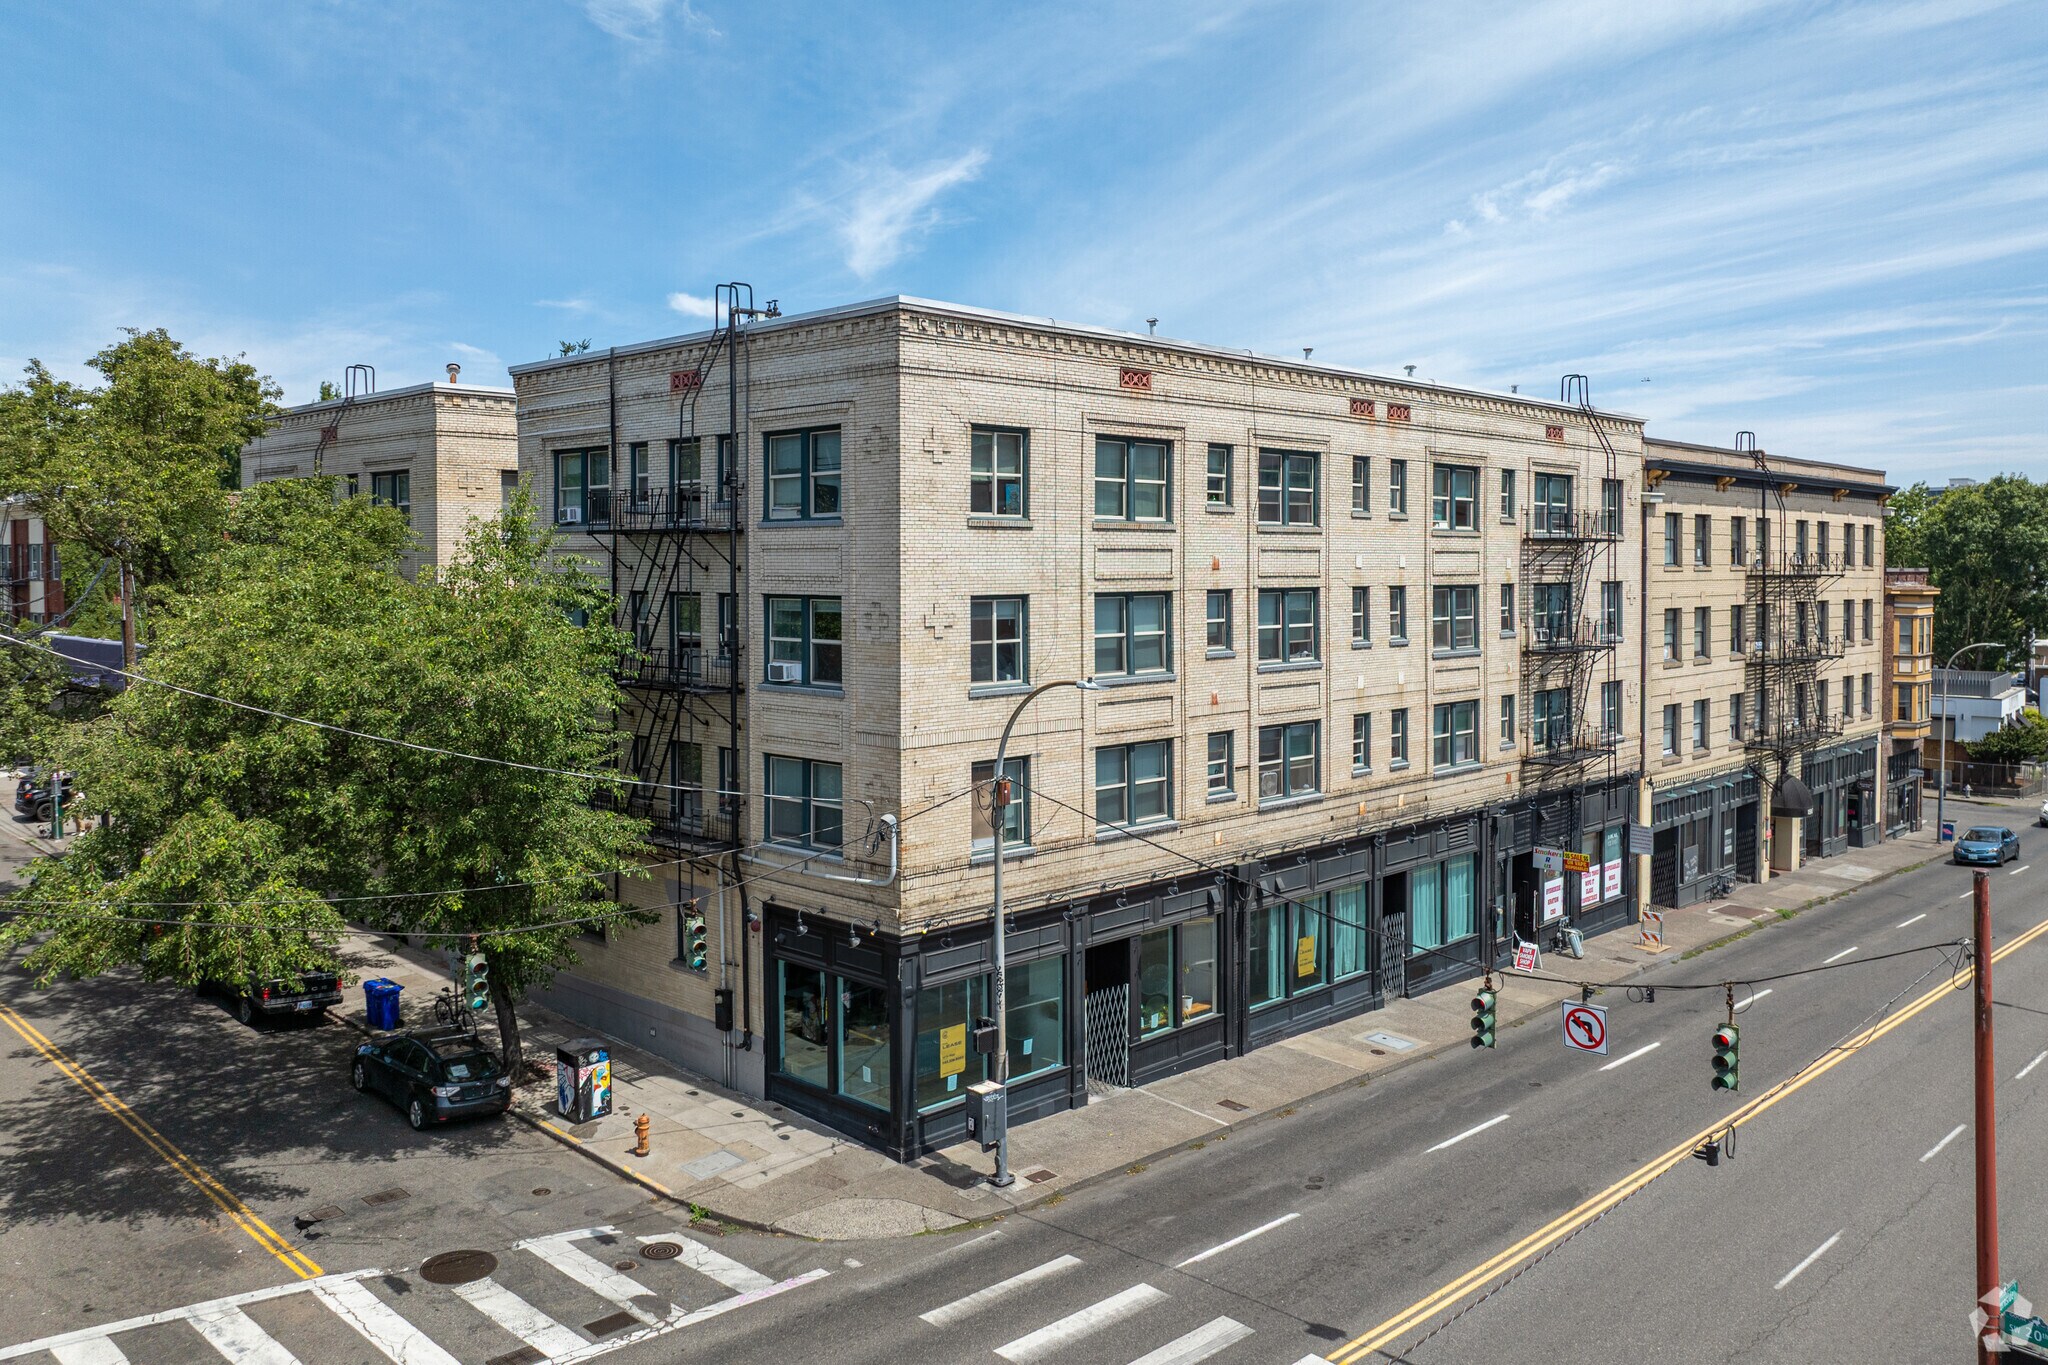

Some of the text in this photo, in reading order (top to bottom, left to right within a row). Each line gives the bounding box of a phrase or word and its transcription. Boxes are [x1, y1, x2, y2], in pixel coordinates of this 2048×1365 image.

[1534, 848, 1562, 858] Smokers
[1570, 853, 1583, 861] SALE
[942, 1040, 962, 1050] LEASE
[2009, 1324, 2020, 1334] SW
